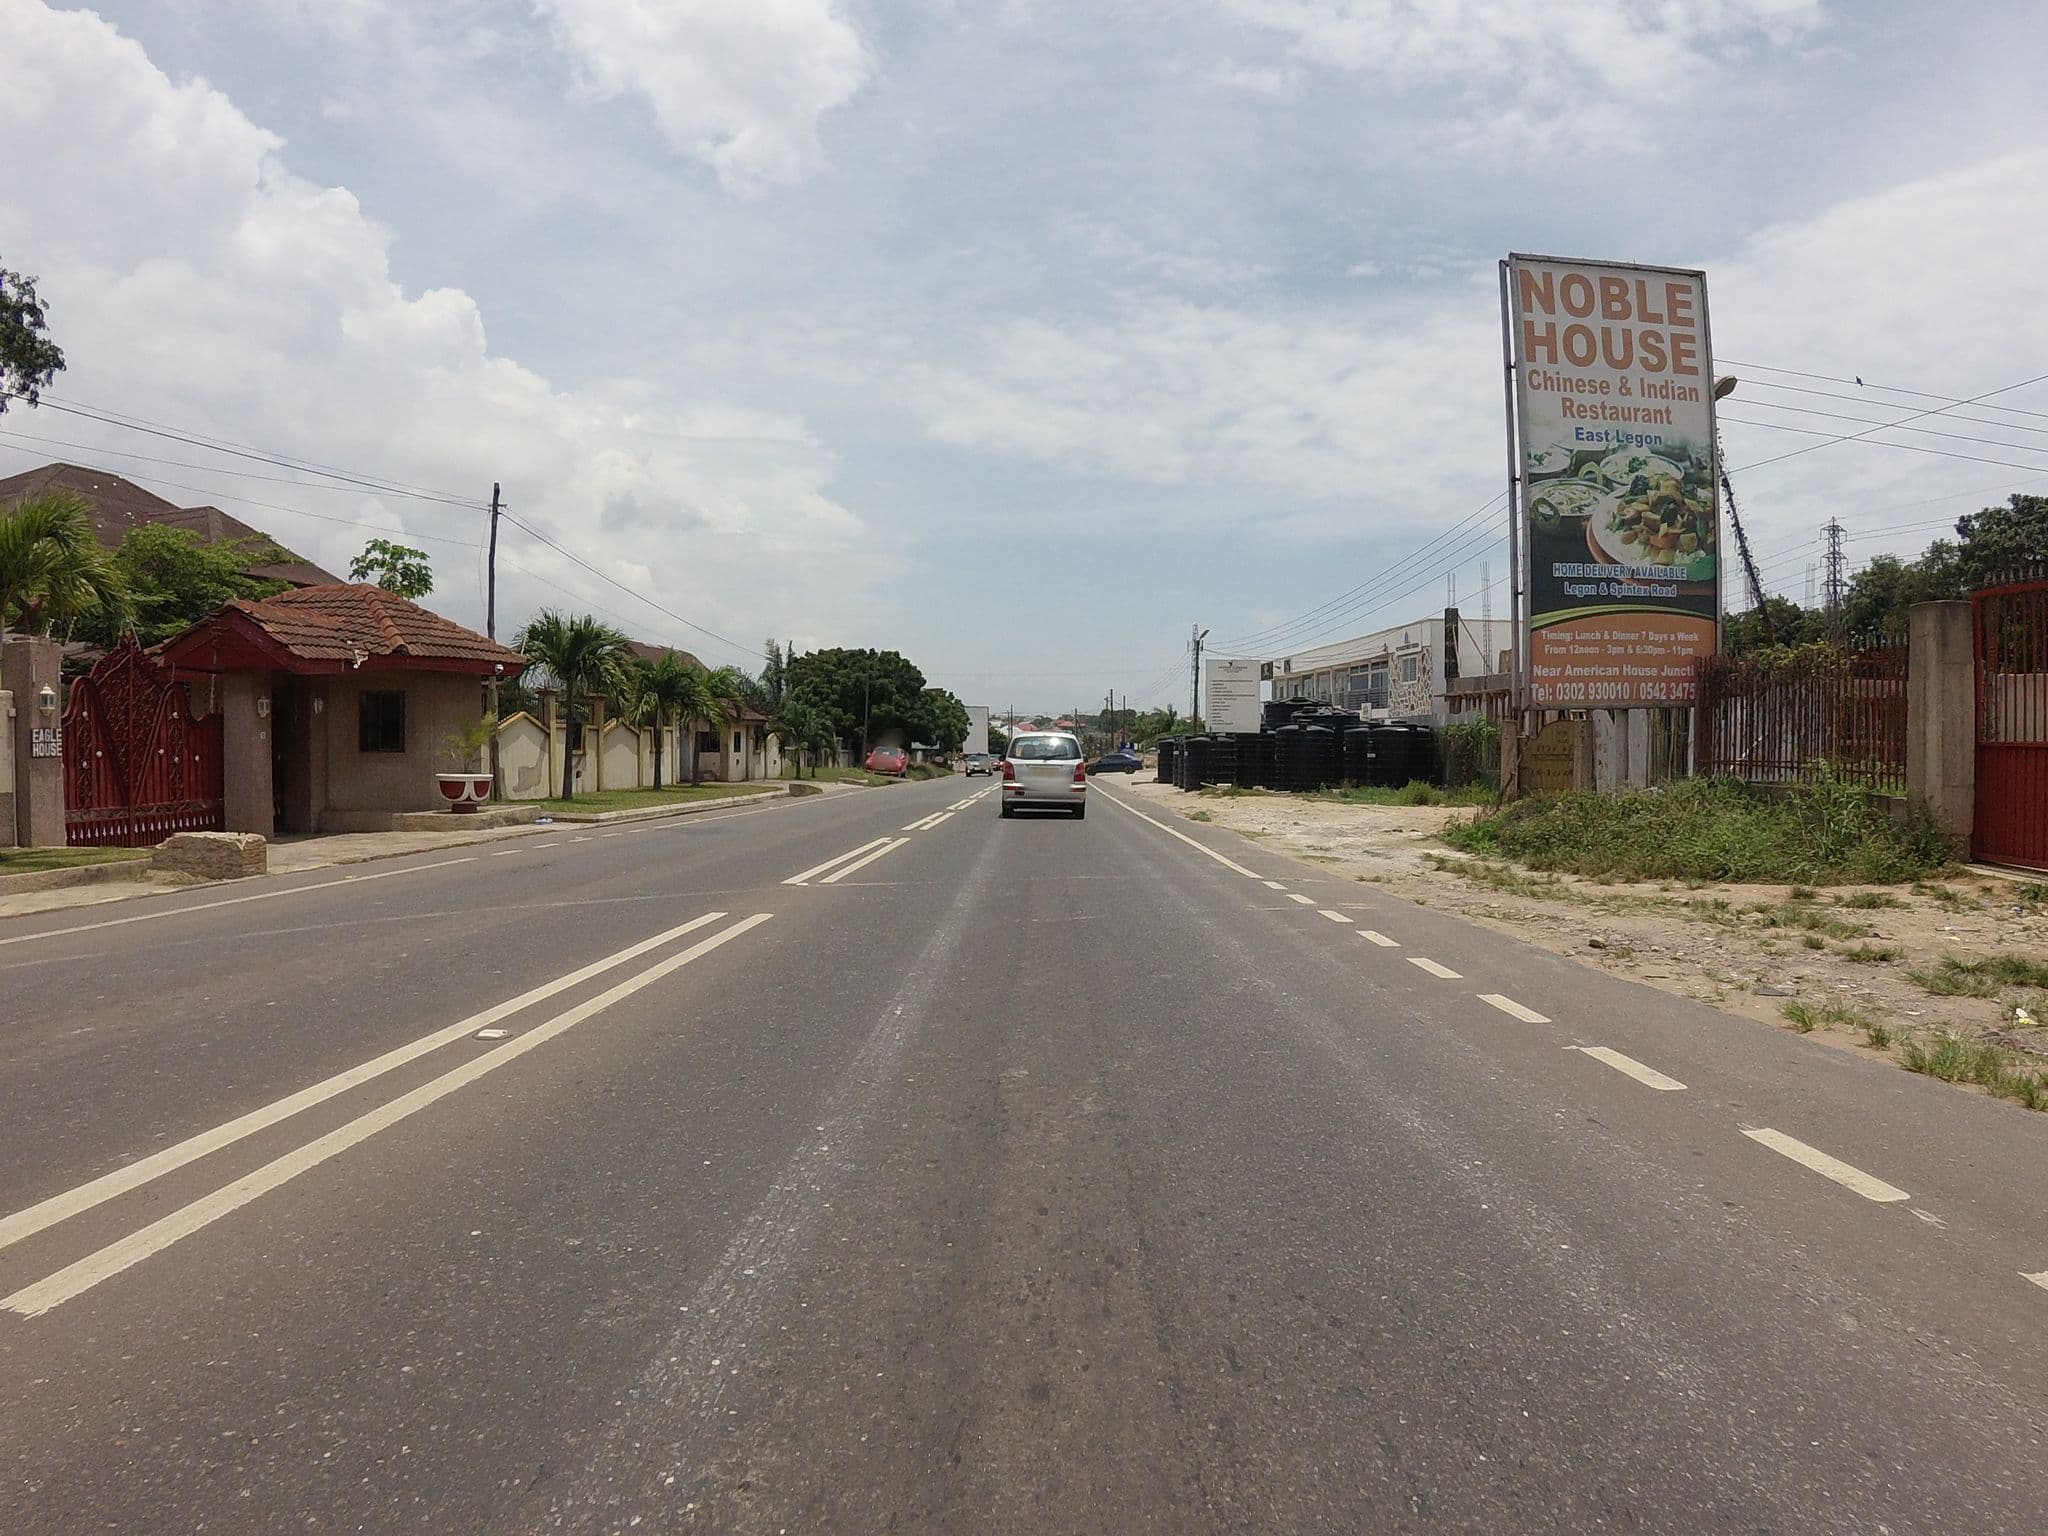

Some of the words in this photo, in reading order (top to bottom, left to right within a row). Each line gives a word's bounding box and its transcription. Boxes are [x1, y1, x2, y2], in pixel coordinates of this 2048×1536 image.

[1518, 269, 1695, 328] NOBLE
[1523, 320, 1699, 376] HOUSE
[1528, 369, 1610, 395] Chinese
[1618, 375, 1632, 396] &
[1640, 377, 1699, 402] Indian
[1561, 397, 1672, 425] Restaurant
[1575, 427, 1610, 442] East
[1616, 429, 1662, 448] Legon
[1553, 563, 1582, 577] HOME
[1584, 564, 1633, 578] DELIVERY
[1635, 565, 1687, 579] AVAILABLE
[1564, 582, 1597, 597] Legon
[1599, 582, 1608, 595] &
[1610, 582, 1649, 598] Spintex
[1651, 584, 1676, 597] Road
[1541, 630, 1573, 642] Timing:
[1575, 630, 1600, 640] Lunch
[1603, 631, 1609, 640] &
[1613, 630, 1639, 640] Dinner
[1641, 631, 1646, 640] 7
[1648, 631, 1668, 643] Days
[1677, 632, 1699, 641] Week
[1544, 645, 1566, 654] From
[1569, 644, 1599, 654] 12noon
[1607, 644, 1624, 656] 3pm
[1627, 645, 1633, 654] &
[1672, 645, 1693, 656] 11pm
[1533, 664, 1561, 676] Near
[1564, 664, 1619, 676] American
[1623, 664, 1657, 676] House
[1661, 665, 1695, 676] Juncti
[1531, 683, 1553, 701] Tel:
[1556, 682, 1585, 700] 0302
[1588, 682, 1629, 700] 930010
[1633, 682, 1637, 699] /
[1640, 682, 1667, 700] 0542
[1670, 682, 1695, 700] 3475
[32, 729, 62, 743] EAGLE
[32, 743, 62, 757] HOUSE
